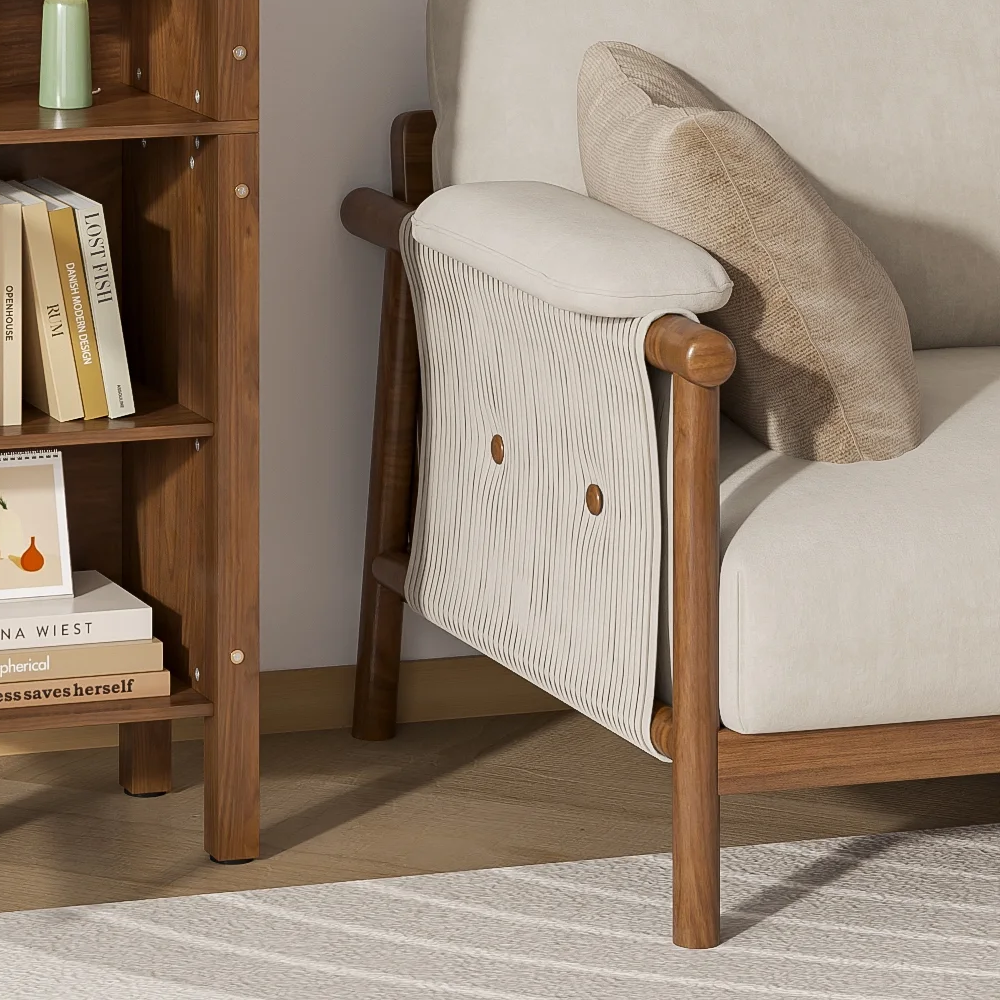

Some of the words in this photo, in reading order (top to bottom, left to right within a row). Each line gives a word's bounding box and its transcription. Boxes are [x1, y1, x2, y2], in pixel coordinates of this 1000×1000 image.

[84, 212, 106, 258] LOST
[65, 262, 79, 297] DANISH
[92, 262, 113, 304] FISH
[5, 285, 14, 341] OPENHOUSE
[47, 303, 64, 337] RUM
[72, 295, 87, 333] MODERN
[78, 333, 92, 365] DESIGN
[36, 622, 93, 638] WIEST
[23, 687, 71, 700] saves
[72, 678, 135, 697] herself
